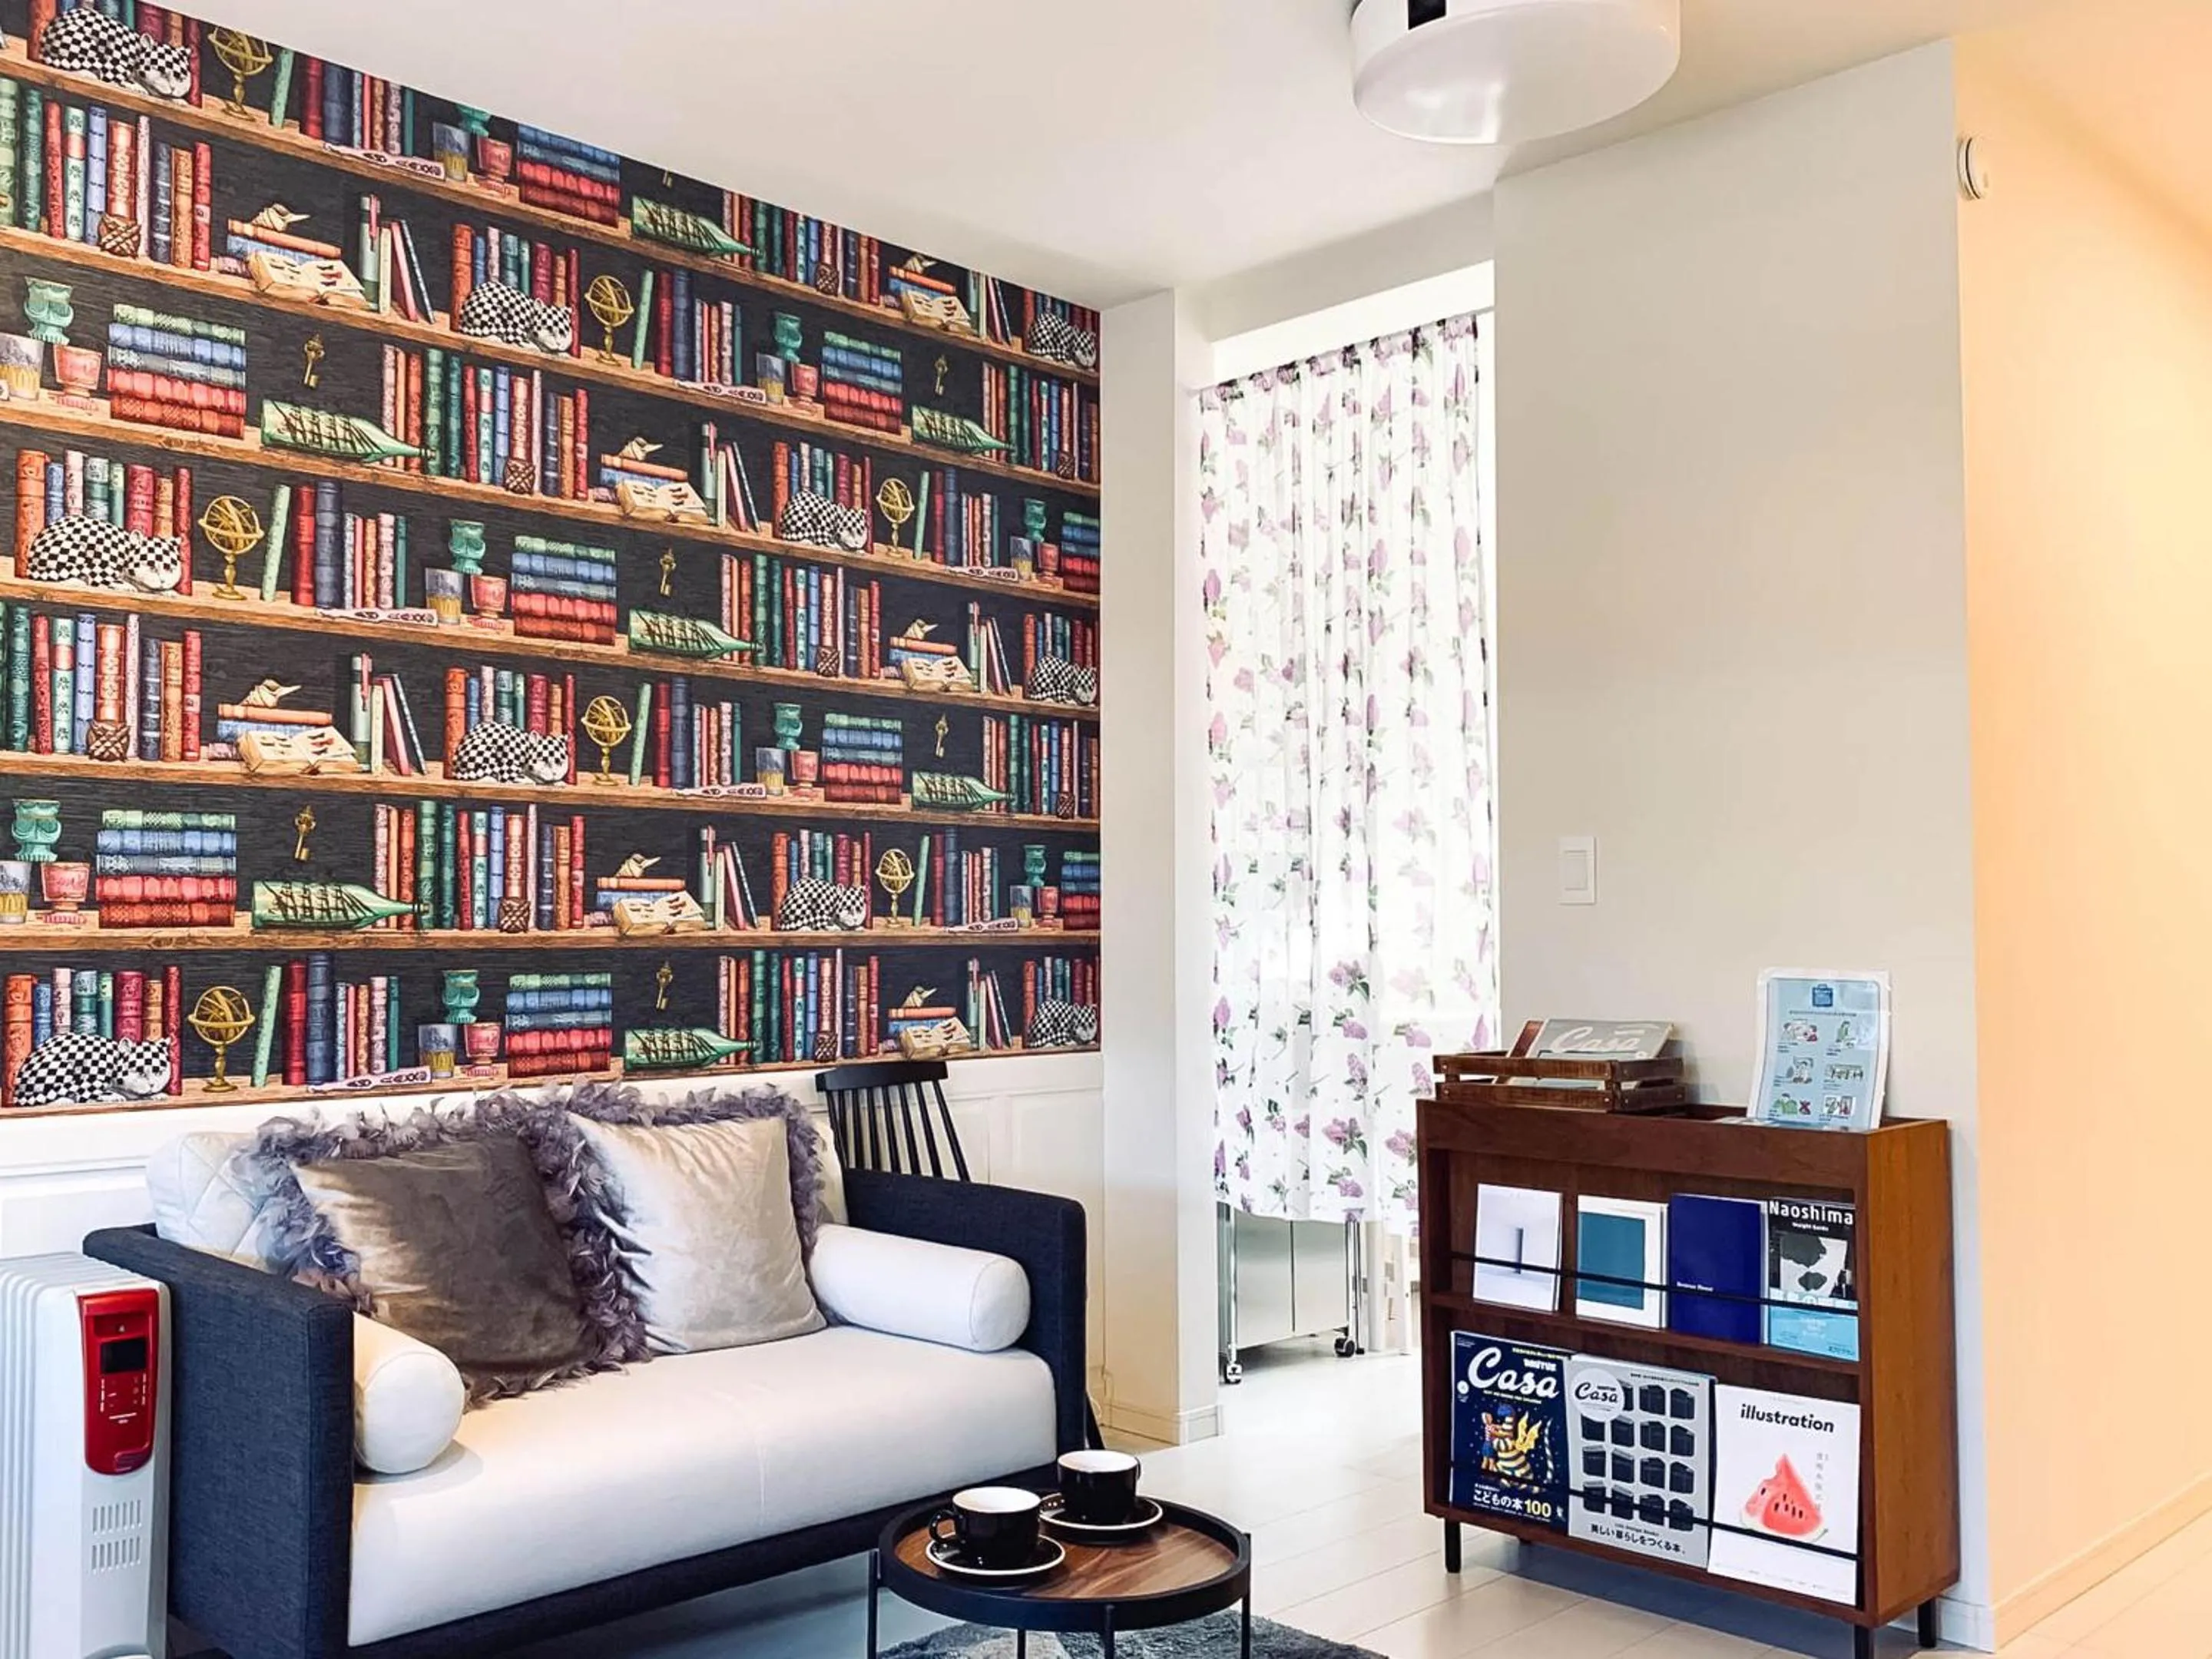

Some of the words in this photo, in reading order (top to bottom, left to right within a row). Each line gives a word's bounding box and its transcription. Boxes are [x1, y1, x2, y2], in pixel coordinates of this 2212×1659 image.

[1552, 1026, 1640, 1053] Casa
[1769, 1200, 1853, 1225] Naoshima
[1468, 1346, 1559, 1399] Casa
[1575, 1382, 1618, 1403] Casa
[1740, 1403, 1834, 1432] illustration
